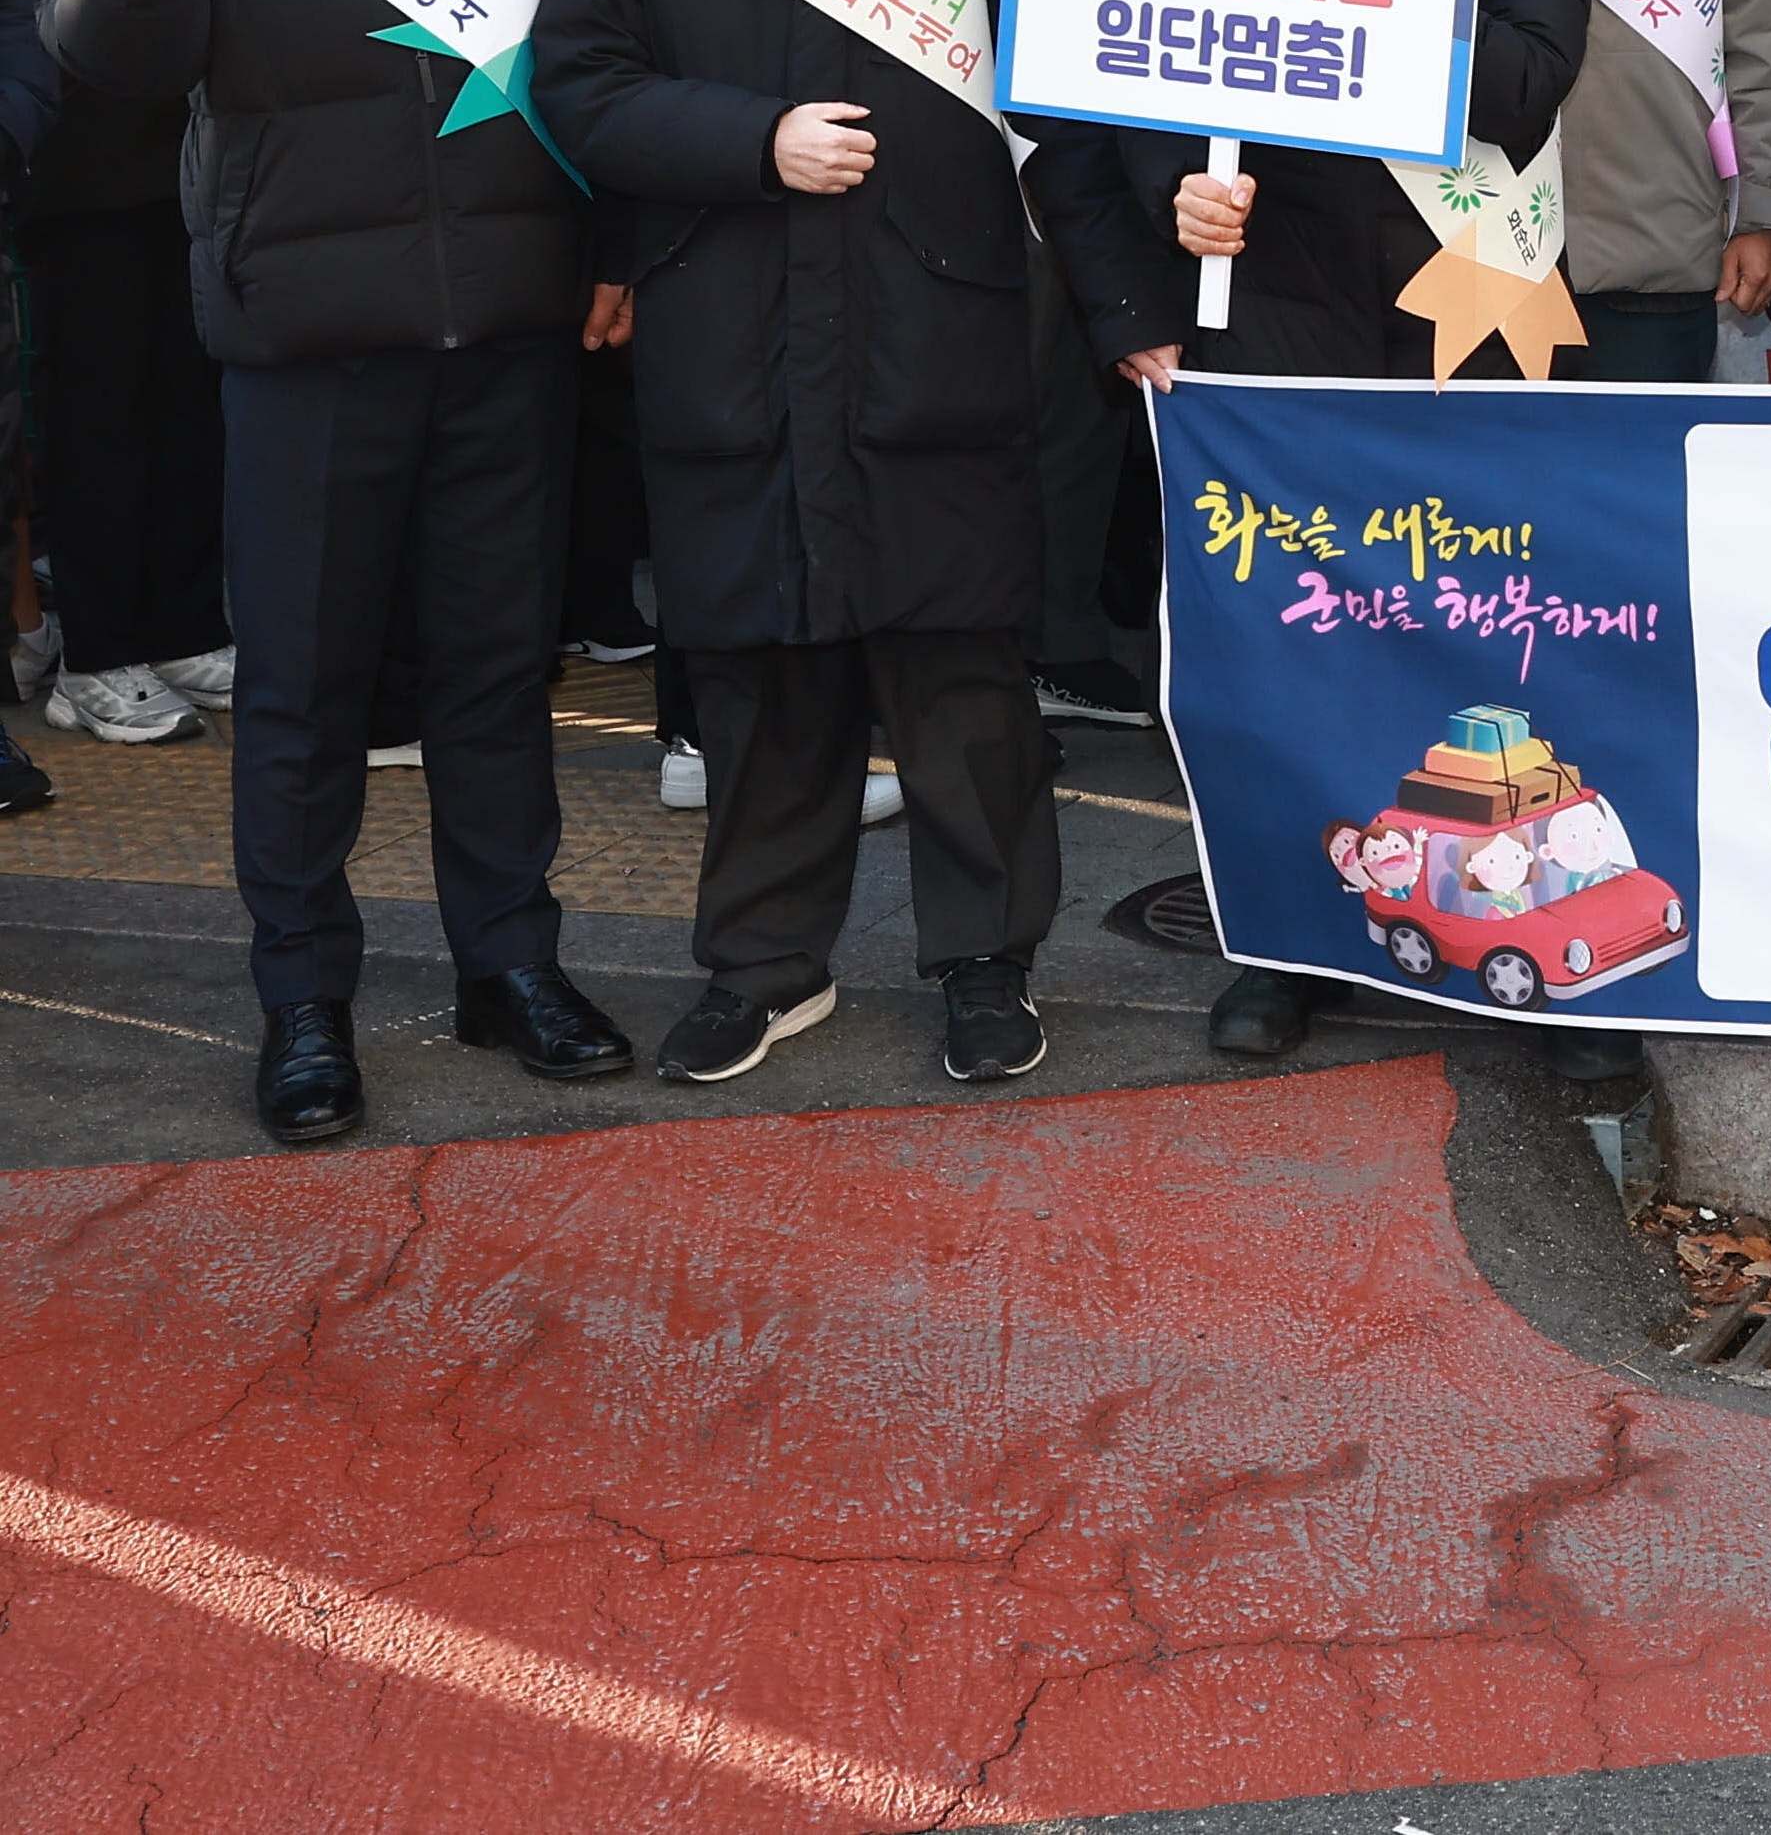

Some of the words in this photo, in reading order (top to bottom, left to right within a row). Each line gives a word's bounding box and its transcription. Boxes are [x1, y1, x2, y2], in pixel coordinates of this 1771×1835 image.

[1096, 0, 1367, 102] 일단멈춤!
[1507, 207, 1536, 266] 화순군
[1195, 481, 1345, 583] 화순을
[1363, 497, 1533, 581] 새롭게!
[1280, 571, 1424, 631] 군민을
[1433, 574, 1659, 685] 행복하게!
